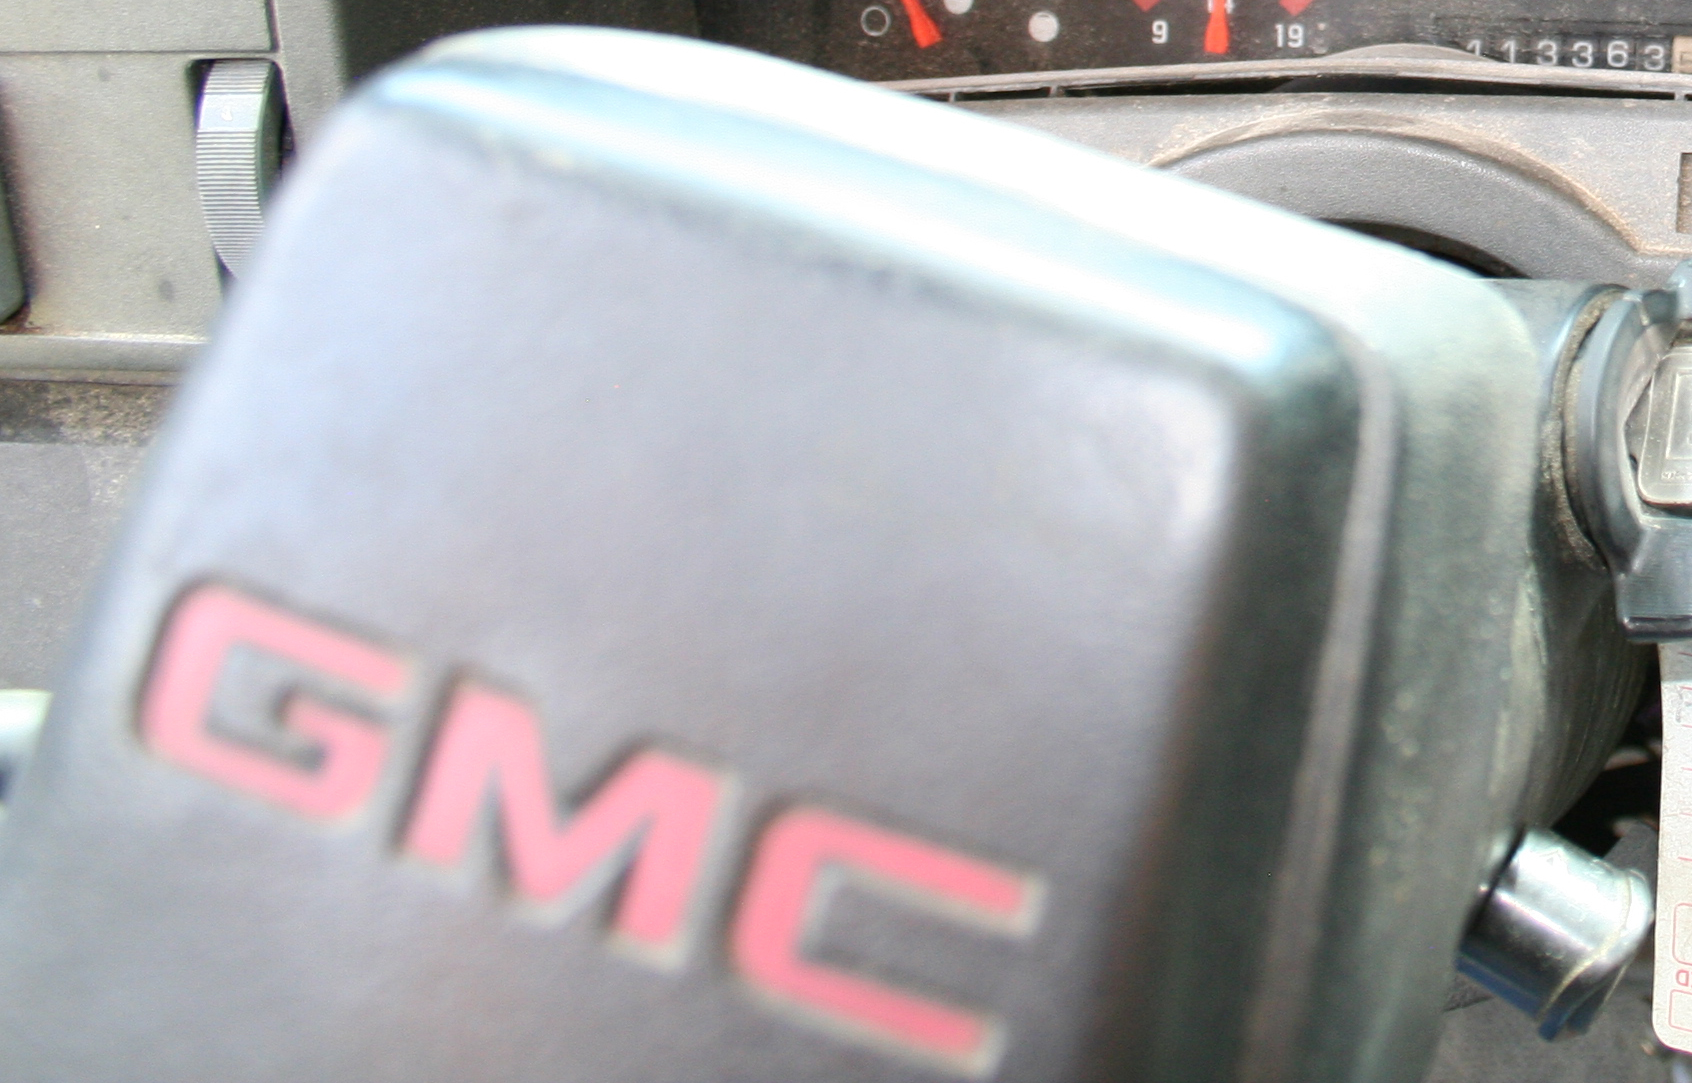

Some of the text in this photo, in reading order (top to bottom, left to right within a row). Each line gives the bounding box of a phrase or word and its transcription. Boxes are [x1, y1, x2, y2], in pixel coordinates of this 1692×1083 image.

[1150, 19, 1170, 45] 9
[1274, 22, 1305, 49] 19
[137, 581, 1042, 1072] GMC
